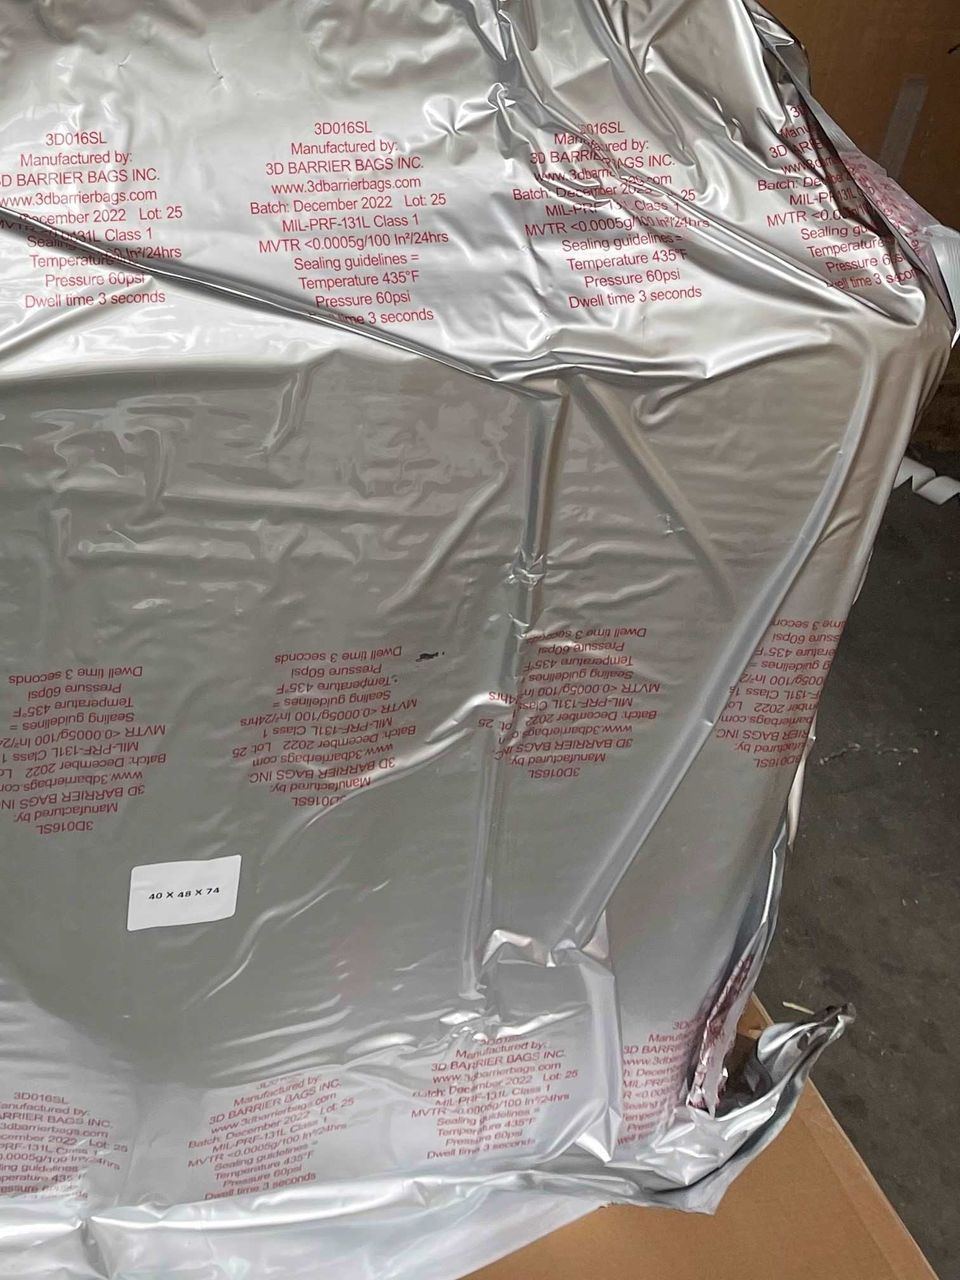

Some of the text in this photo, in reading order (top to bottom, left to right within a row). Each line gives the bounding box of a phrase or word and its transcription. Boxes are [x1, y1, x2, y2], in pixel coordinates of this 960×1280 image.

[314, 121, 372, 134] 3D016SL
[45, 132, 107, 146] 3D016SL
[291, 140, 398, 155] Manufactured by:
[265, 157, 424, 175] 3D BARRIER BAGS INC.
[16, 172, 83, 186] BARRIER
[88, 170, 128, 183] BAGS
[132, 169, 160, 181] INC.
[271, 178, 421, 194] www.3dbarrierbags.com
[250, 194, 446, 214] Batch: December 2022 Lot: 25
[93, 209, 126, 222] 2022
[282, 213, 419, 232] MIL-PRF-131L Class 1
[800, 224, 848, 241] Sealing
[258, 239, 301, 252] MVTR
[294, 257, 341, 271] Sealing
[344, 254, 407, 270] guidelines
[299, 274, 379, 291] Temperature
[646, 268, 681, 284] 60psi
[315, 291, 411, 307] Pressure 60psi
[569, 287, 702, 307] Dwell 3 seconds
[368, 308, 434, 324] 3 seconds
[28, 687, 61, 701] 60psi
[745, 687, 779, 699] Class
[54, 697, 134, 712] Temperature
[753, 702, 785, 713] 2022
[125, 725, 166, 738] MVTR
[311, 718, 393, 734] MIL-PRF-131L
[283, 738, 314, 750] 2022
[555, 738, 613, 749] BARRIER
[1, 741, 139, 763] MIL-PRF-131L Class 1
[25, 757, 125, 776] December 2022
[61, 787, 124, 803] BARRIER
[128, 785, 145, 796] 3D
[19, 793, 57, 807] BAGS
[34, 802, 118, 821] Manufactured
[36, 820, 94, 835] 3D016SL
[148, 892, 163, 900] 40
[165, 891, 174, 899] X
[177, 890, 192, 898] 48
[206, 887, 220, 895] 74
